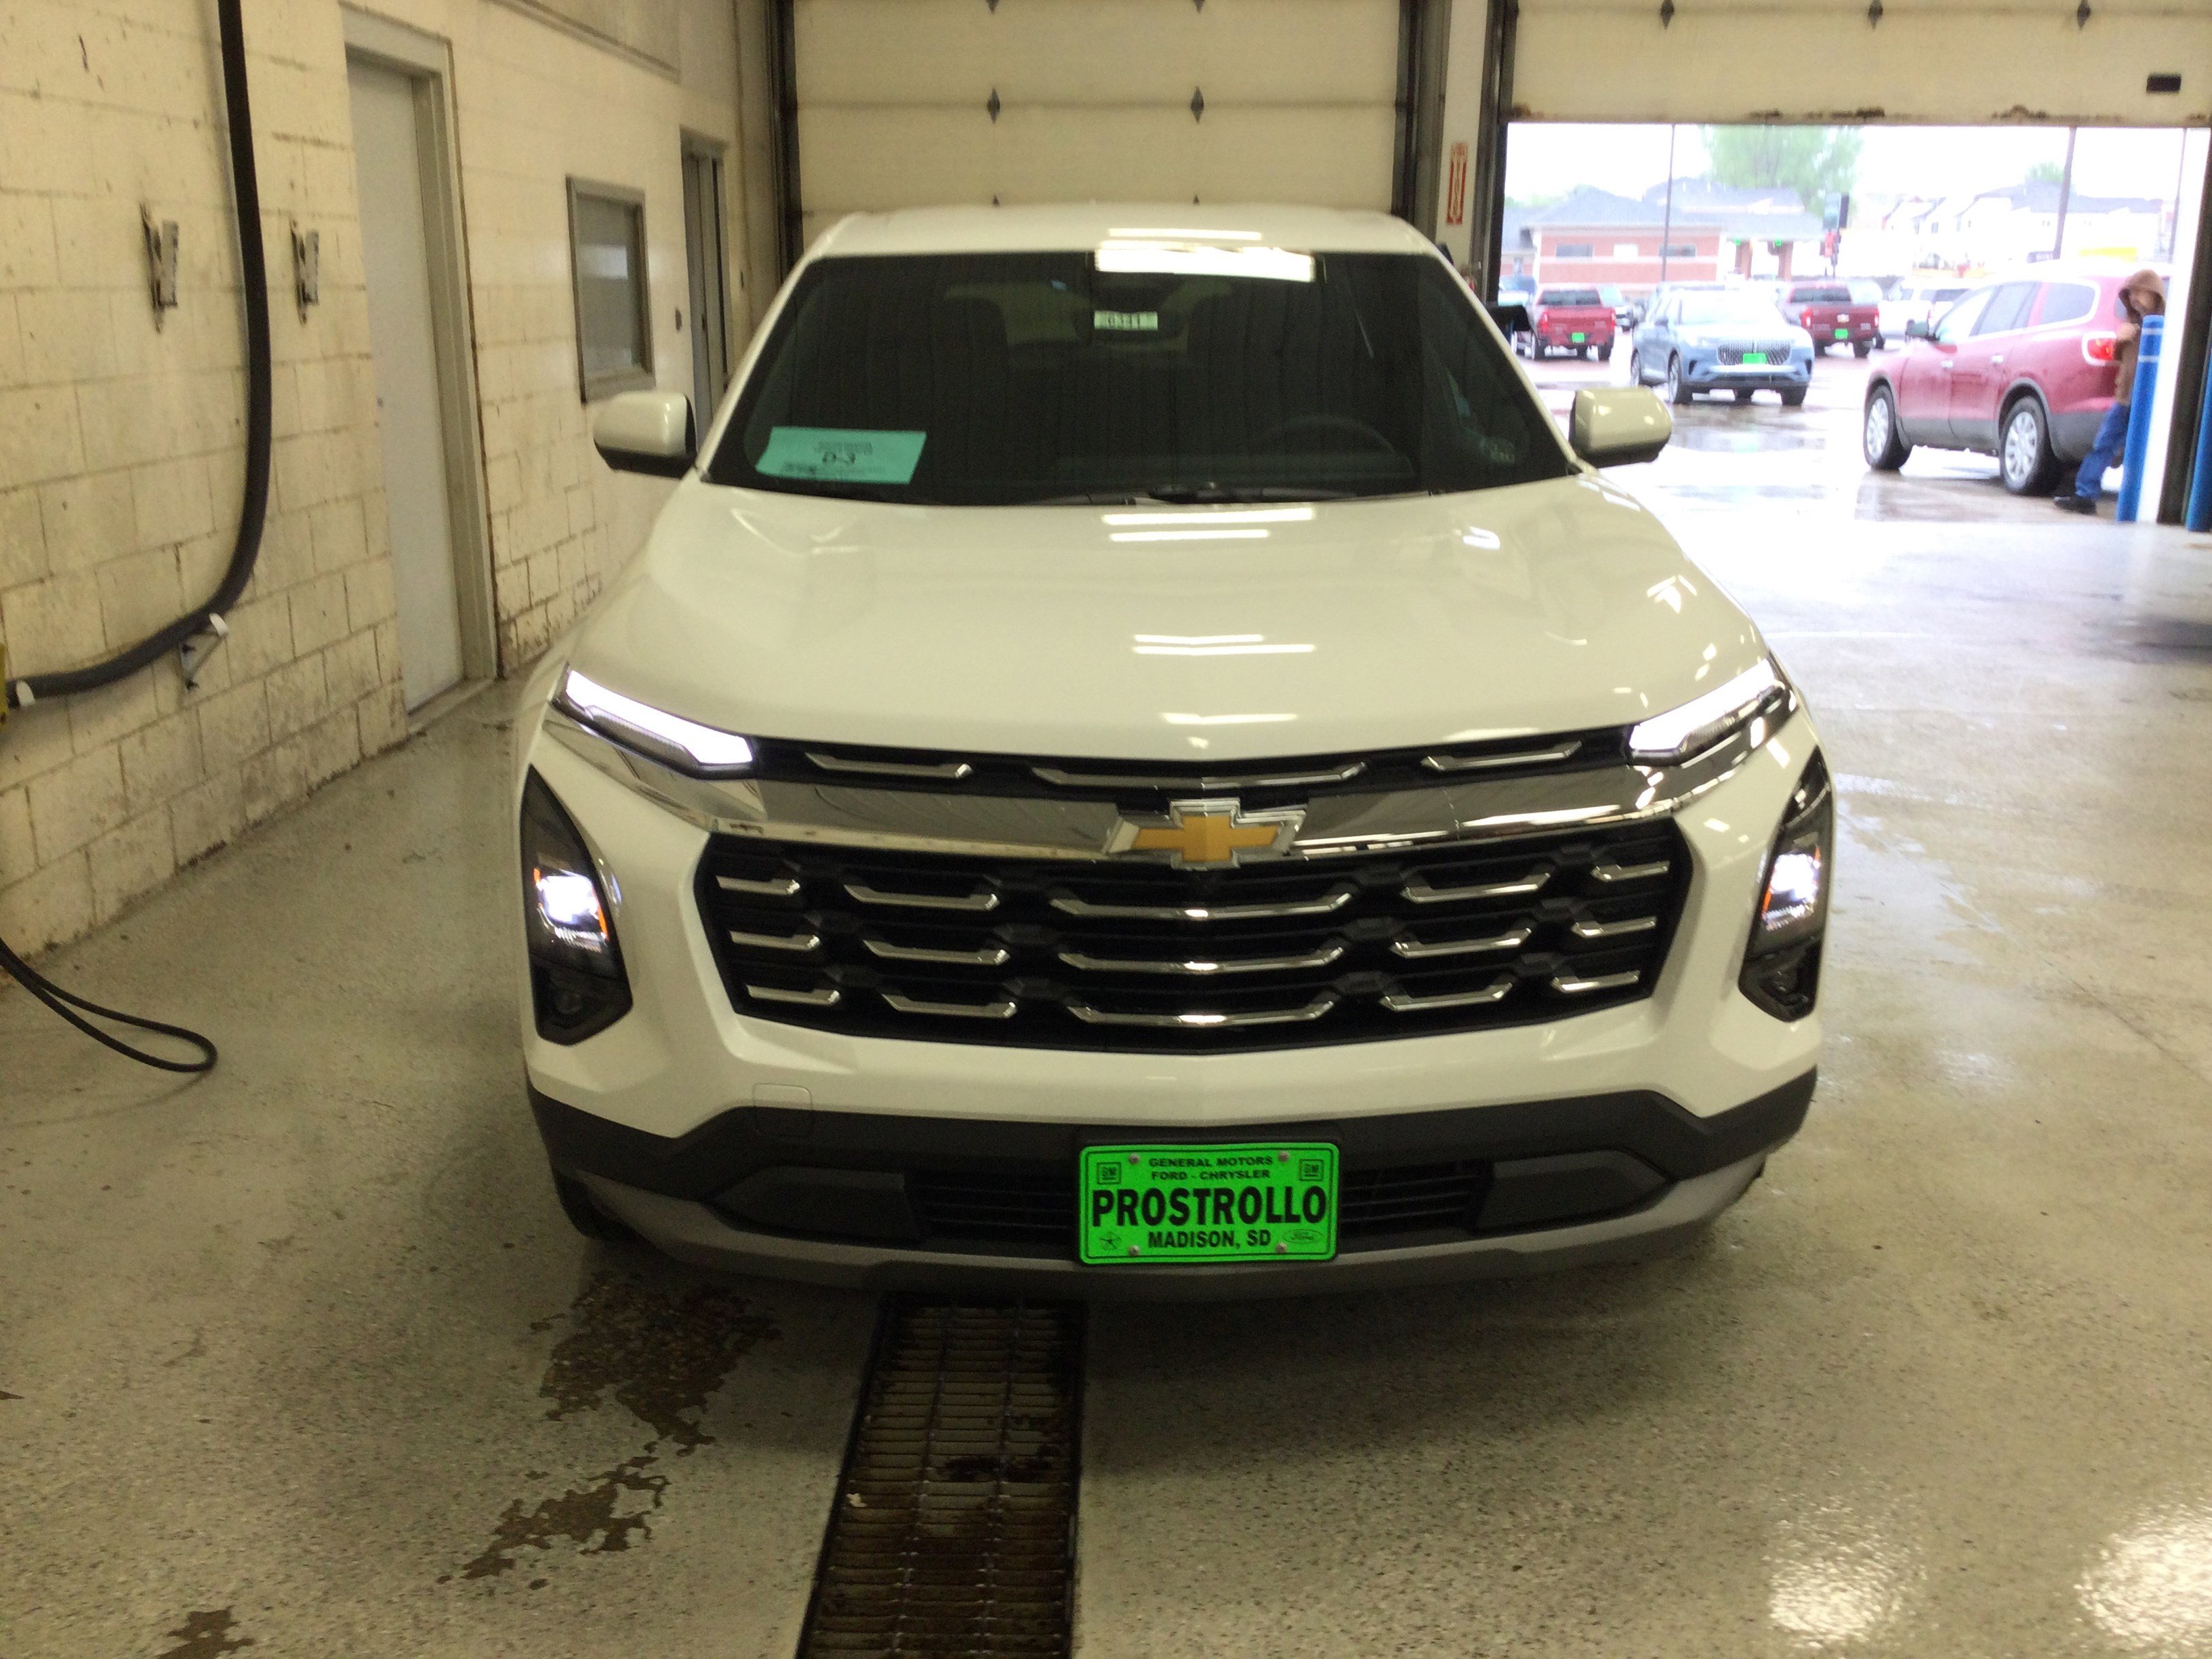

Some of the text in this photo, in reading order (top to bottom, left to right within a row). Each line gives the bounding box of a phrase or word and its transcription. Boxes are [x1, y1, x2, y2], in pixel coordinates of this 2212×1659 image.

[1149, 1156, 1273, 1167] GENERAL MOTORS
[1151, 1171, 1187, 1180] FORD
[1199, 1169, 1270, 1180] CHRYSLER
[1092, 1185, 1327, 1227] PROSTROLLO
[1148, 1229, 1271, 1249] MADISON, SD
